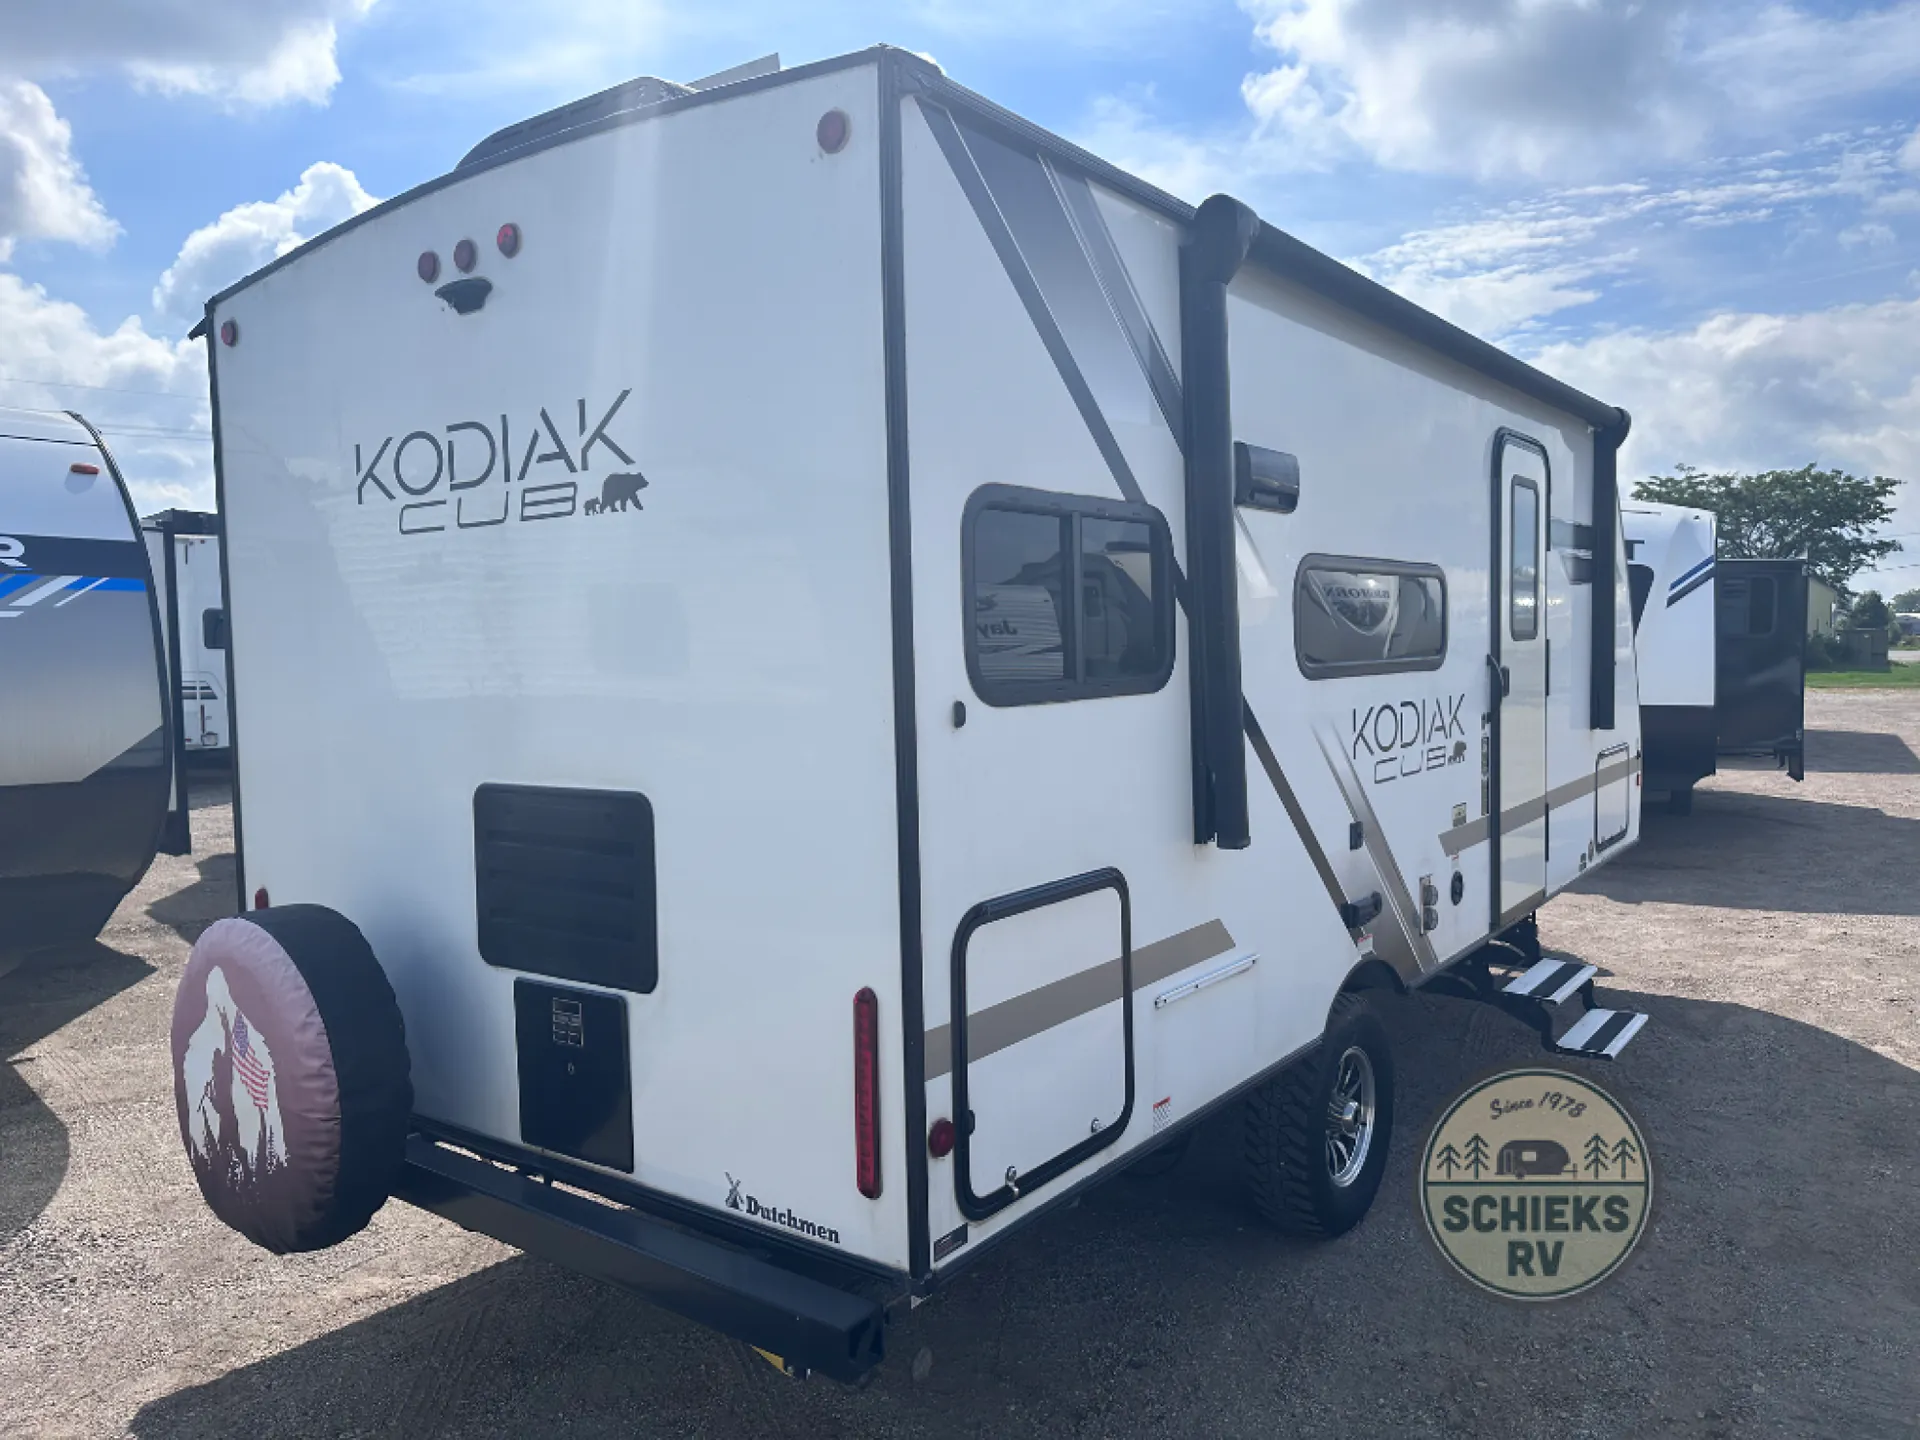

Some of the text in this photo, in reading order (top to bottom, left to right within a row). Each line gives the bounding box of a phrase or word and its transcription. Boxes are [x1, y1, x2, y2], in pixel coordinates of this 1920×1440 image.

[355, 387, 636, 505] KODIAK
[399, 481, 578, 535] CUB
[1352, 693, 1465, 760] KODIAK
[1374, 745, 1446, 784] CUB
[746, 1194, 840, 1243] Dutchmen
